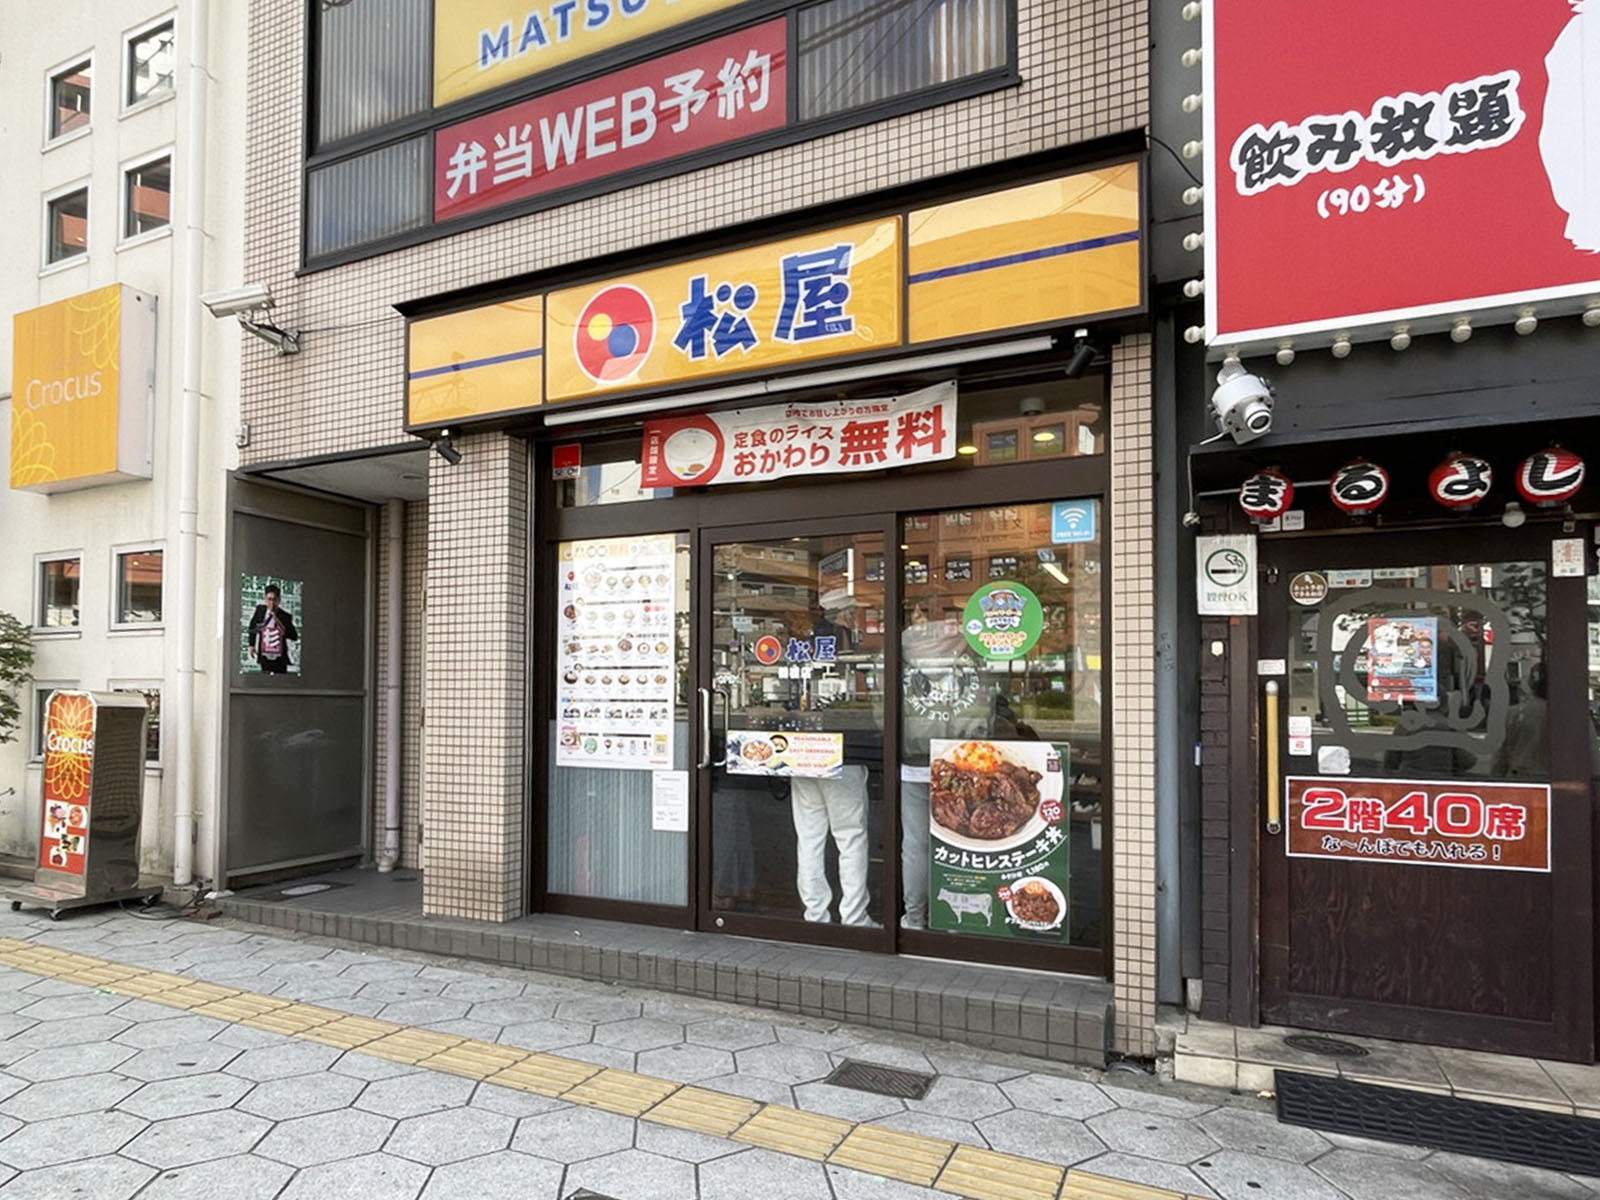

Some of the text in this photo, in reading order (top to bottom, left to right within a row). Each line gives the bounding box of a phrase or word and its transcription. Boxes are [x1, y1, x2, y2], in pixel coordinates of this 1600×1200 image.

[446, 50, 771, 197] 弁当WEB予約
[1238, 78, 1516, 188] 飲み放題
[1317, 174, 1426, 218] (90分)
[673, 244, 854, 360] 松屋
[26, 370, 102, 410] Crocus
[733, 423, 834, 450] 定食のライス
[733, 442, 830, 477] おかわり
[838, 404, 946, 467] 無料
[786, 636, 837, 662] 松屋
[1302, 788, 1526, 840] 2階40席
